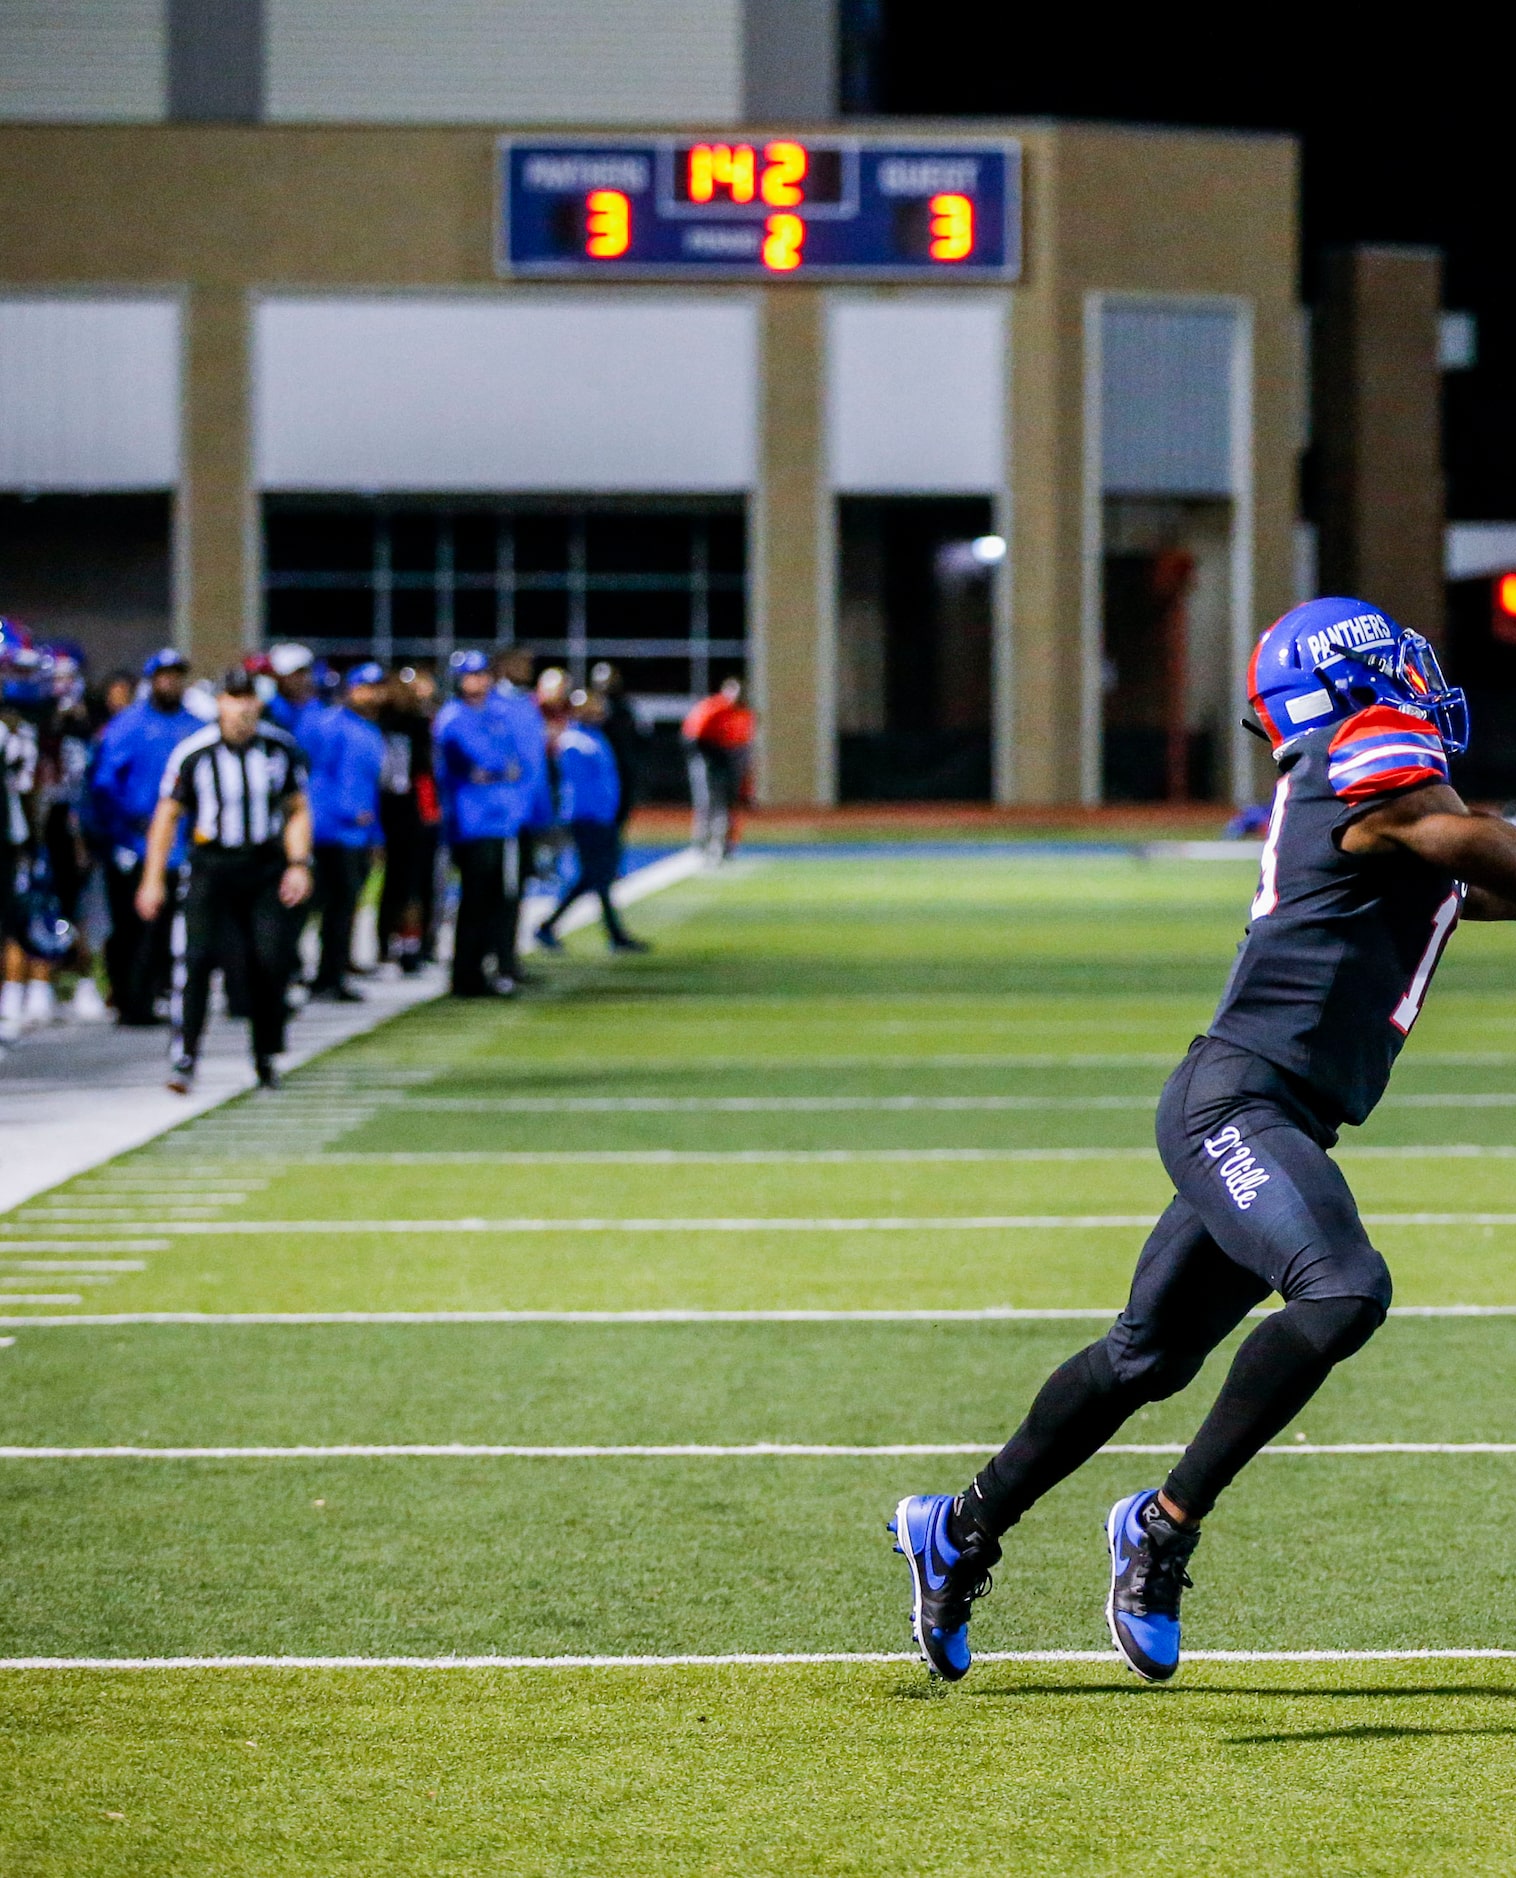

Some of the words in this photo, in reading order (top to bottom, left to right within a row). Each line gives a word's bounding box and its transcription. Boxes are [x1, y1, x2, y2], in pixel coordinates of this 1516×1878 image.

[586, 189, 632, 259] 3
[763, 212, 806, 272] 2
[929, 192, 975, 262] 3
[1307, 613, 1391, 665] PANTHERS
[1203, 1125, 1271, 1210] D'Ville
